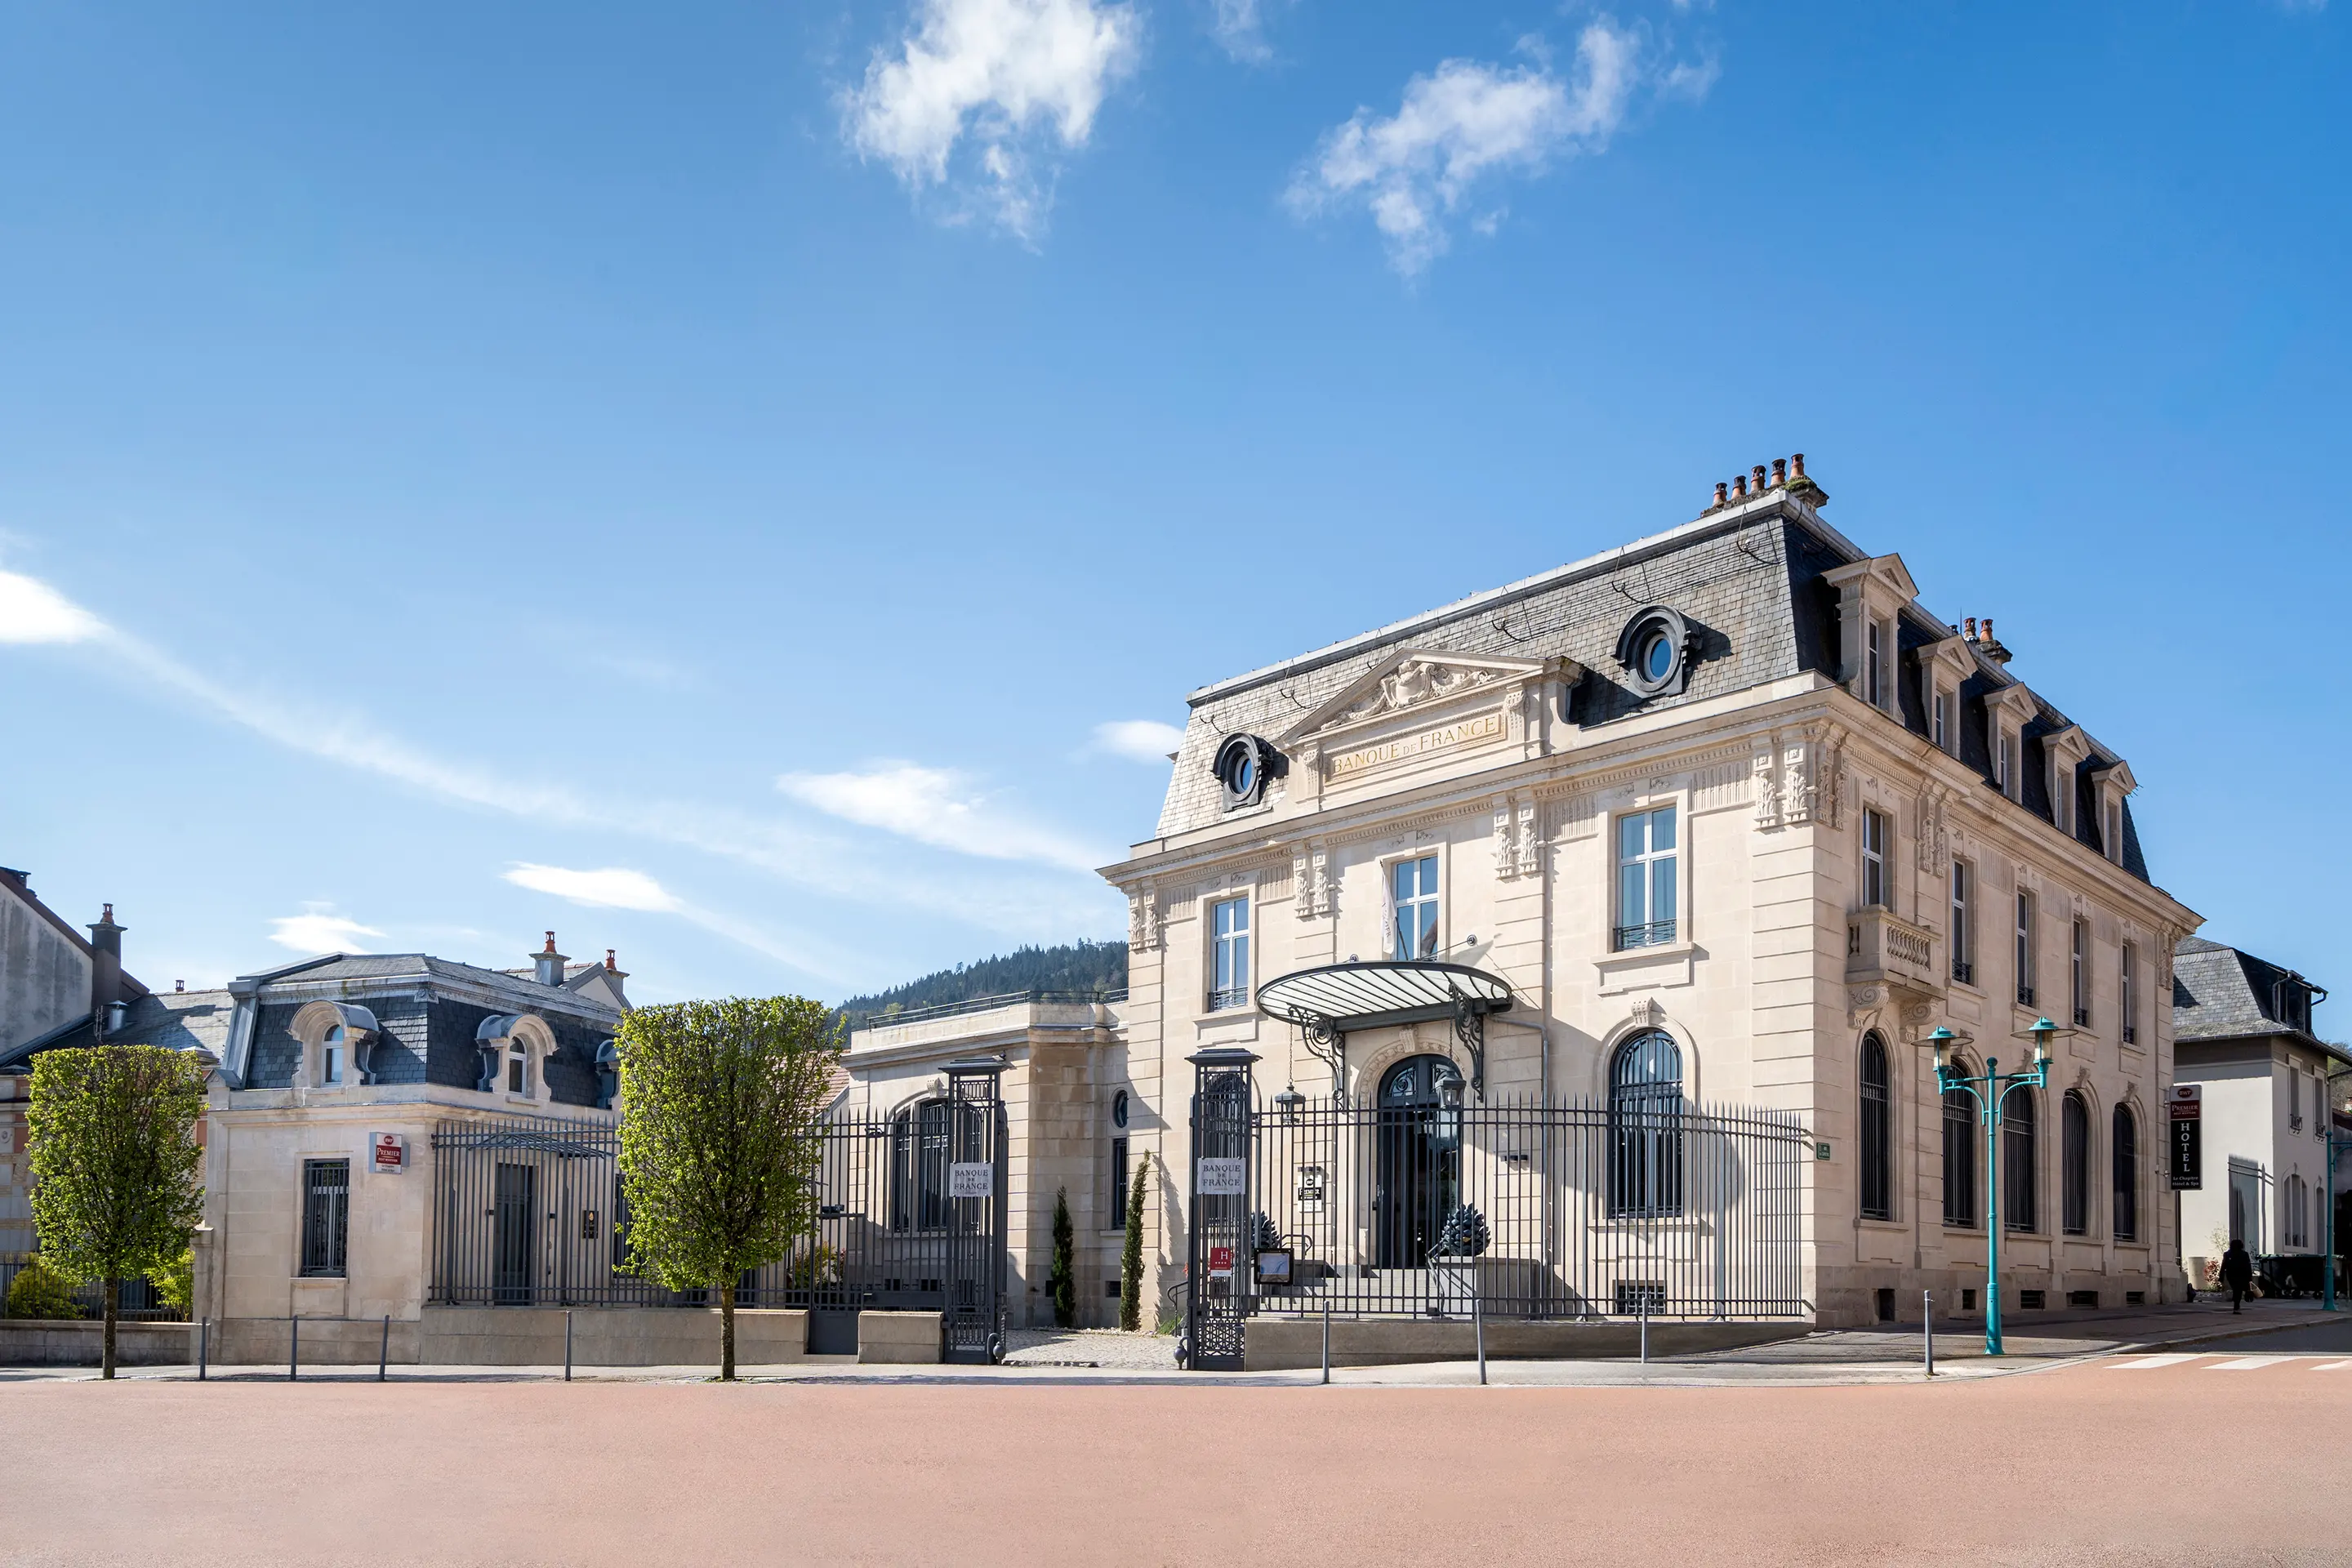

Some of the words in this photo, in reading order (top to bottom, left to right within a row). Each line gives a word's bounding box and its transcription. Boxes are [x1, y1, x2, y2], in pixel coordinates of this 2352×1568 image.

[1334, 742, 1400, 773] BANQUE
[1403, 744, 1417, 755] DE
[1420, 716, 1496, 751] FRANCE
[376, 1147, 400, 1157] PREMIER
[2180, 1123, 2190, 1172] HOTEL
[955, 1169, 989, 1177] BANQUE
[1203, 1164, 1241, 1173] BANQUE
[1202, 1178, 1241, 1187] FRANCE
[1220, 1251, 1228, 1260] H
